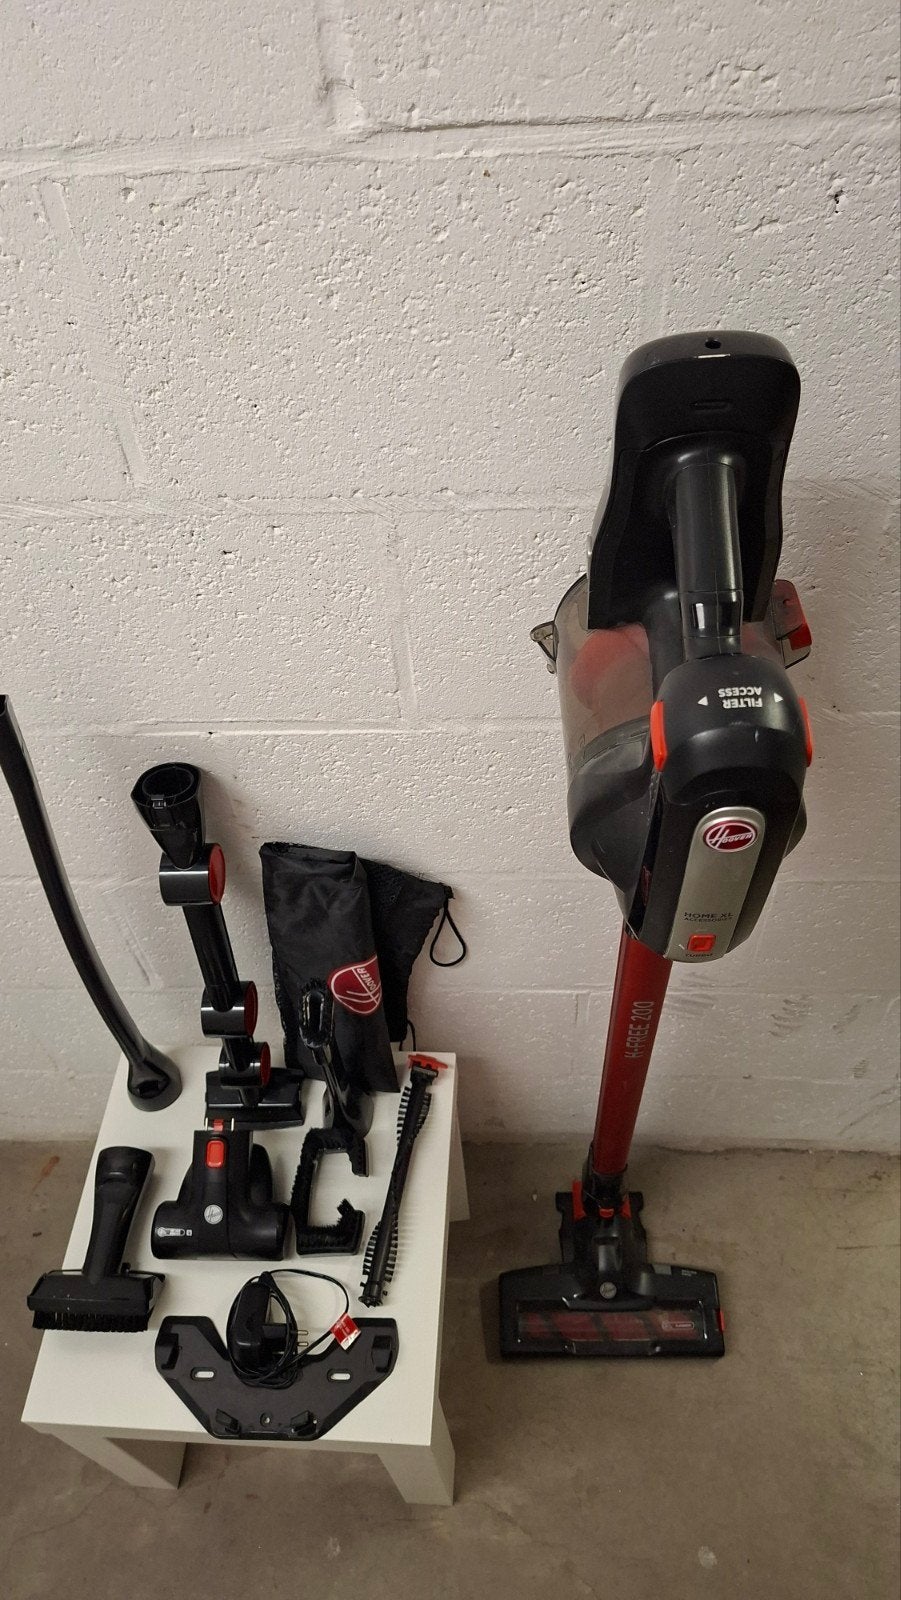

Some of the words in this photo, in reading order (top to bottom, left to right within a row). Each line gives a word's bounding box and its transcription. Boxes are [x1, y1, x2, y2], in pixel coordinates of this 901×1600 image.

[718, 686, 762, 698] ACCESS
[722, 697, 763, 709] FILTER
[630, 1001, 655, 1021] 200
[624, 1023, 650, 1058] H-FREE
